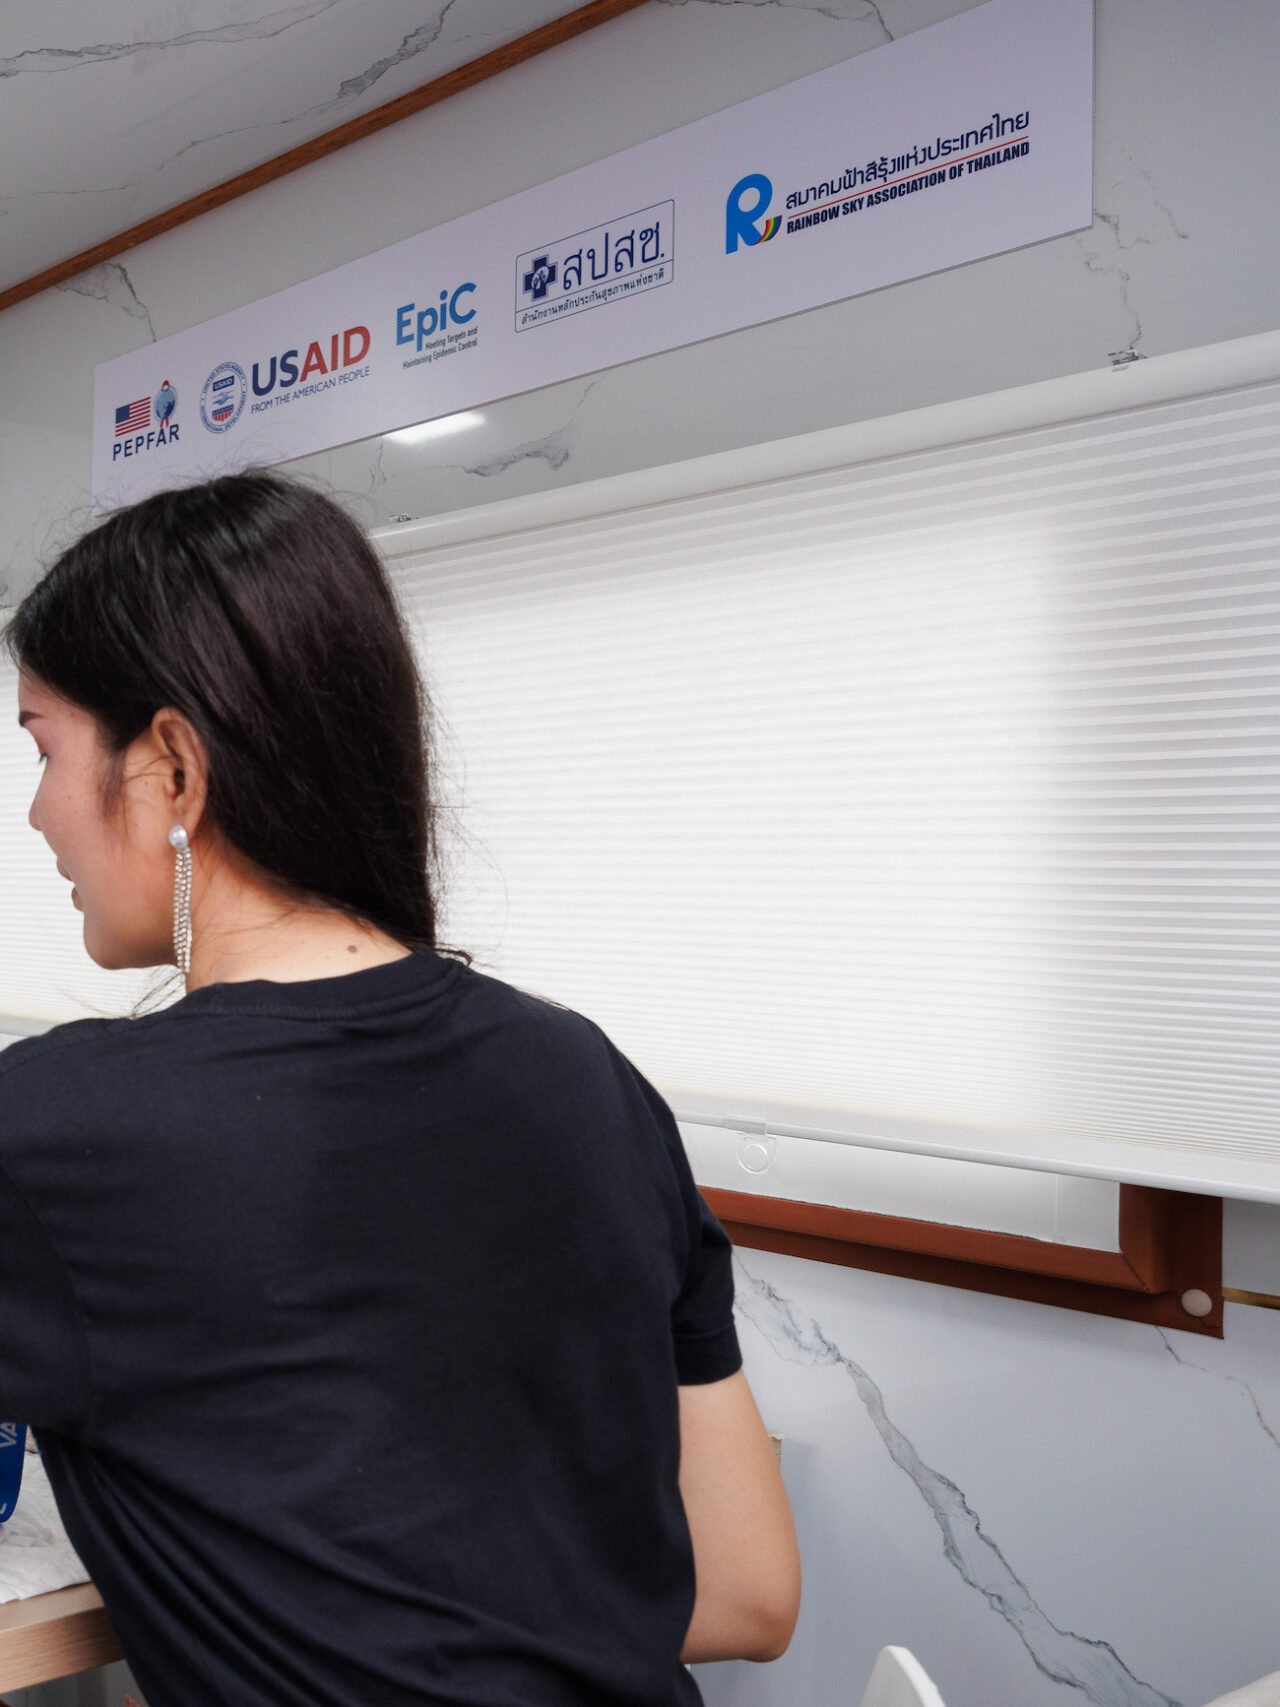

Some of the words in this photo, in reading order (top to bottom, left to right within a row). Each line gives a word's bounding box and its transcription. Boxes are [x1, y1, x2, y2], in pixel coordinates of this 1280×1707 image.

[786, 111, 1030, 210] สมาคมฟ้าสีรุ้งแห่งประเทศไทย
[787, 205, 840, 234] RAINBOW
[842, 197, 865, 216] SKY
[866, 169, 946, 208] ASSOCIATION
[949, 163, 964, 180] OF
[967, 141, 1030, 174] THAILAND
[396, 282, 477, 352] EpiC
[447, 331, 466, 343] Targets
[467, 326, 478, 337] and
[252, 325, 371, 397] USAID
[433, 346, 457, 361] Epidemic
[458, 337, 478, 352] Control
[251, 399, 273, 415] FROM
[274, 393, 291, 406] THE
[292, 377, 337, 401] AMERICAN
[338, 365, 371, 385] PEOPLE
[112, 423, 179, 462] PEPFAR
